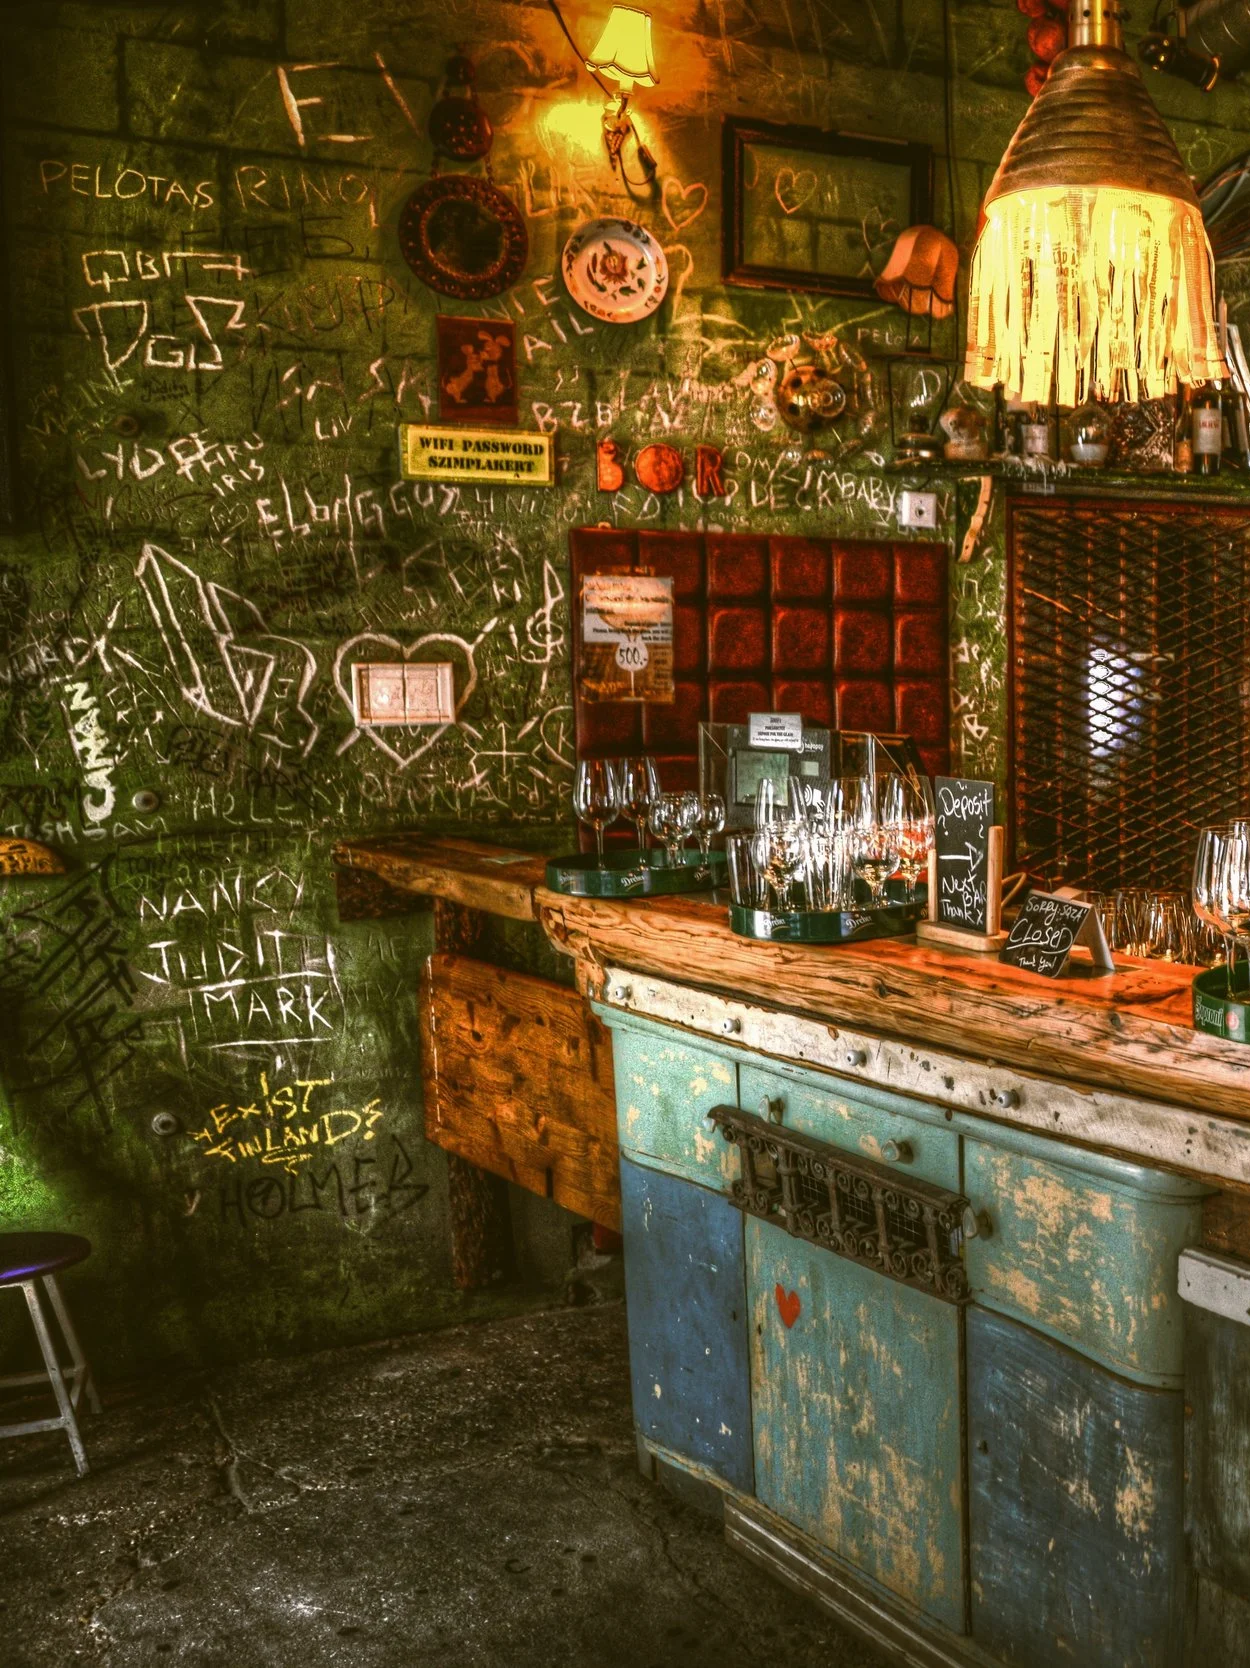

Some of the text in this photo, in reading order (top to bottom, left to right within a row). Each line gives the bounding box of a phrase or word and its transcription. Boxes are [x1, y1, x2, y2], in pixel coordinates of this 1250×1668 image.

[39, 159, 214, 209] PELOTAS
[420, 437, 544, 456] WIFI PASSWORD
[428, 457, 536, 473] SZIMPLAKERT
[938, 787, 993, 820] Deposit
[140, 866, 304, 922] NANCY
[942, 869, 977, 894] Next
[140, 930, 335, 985] JUDITH
[203, 985, 333, 1032] MARK
